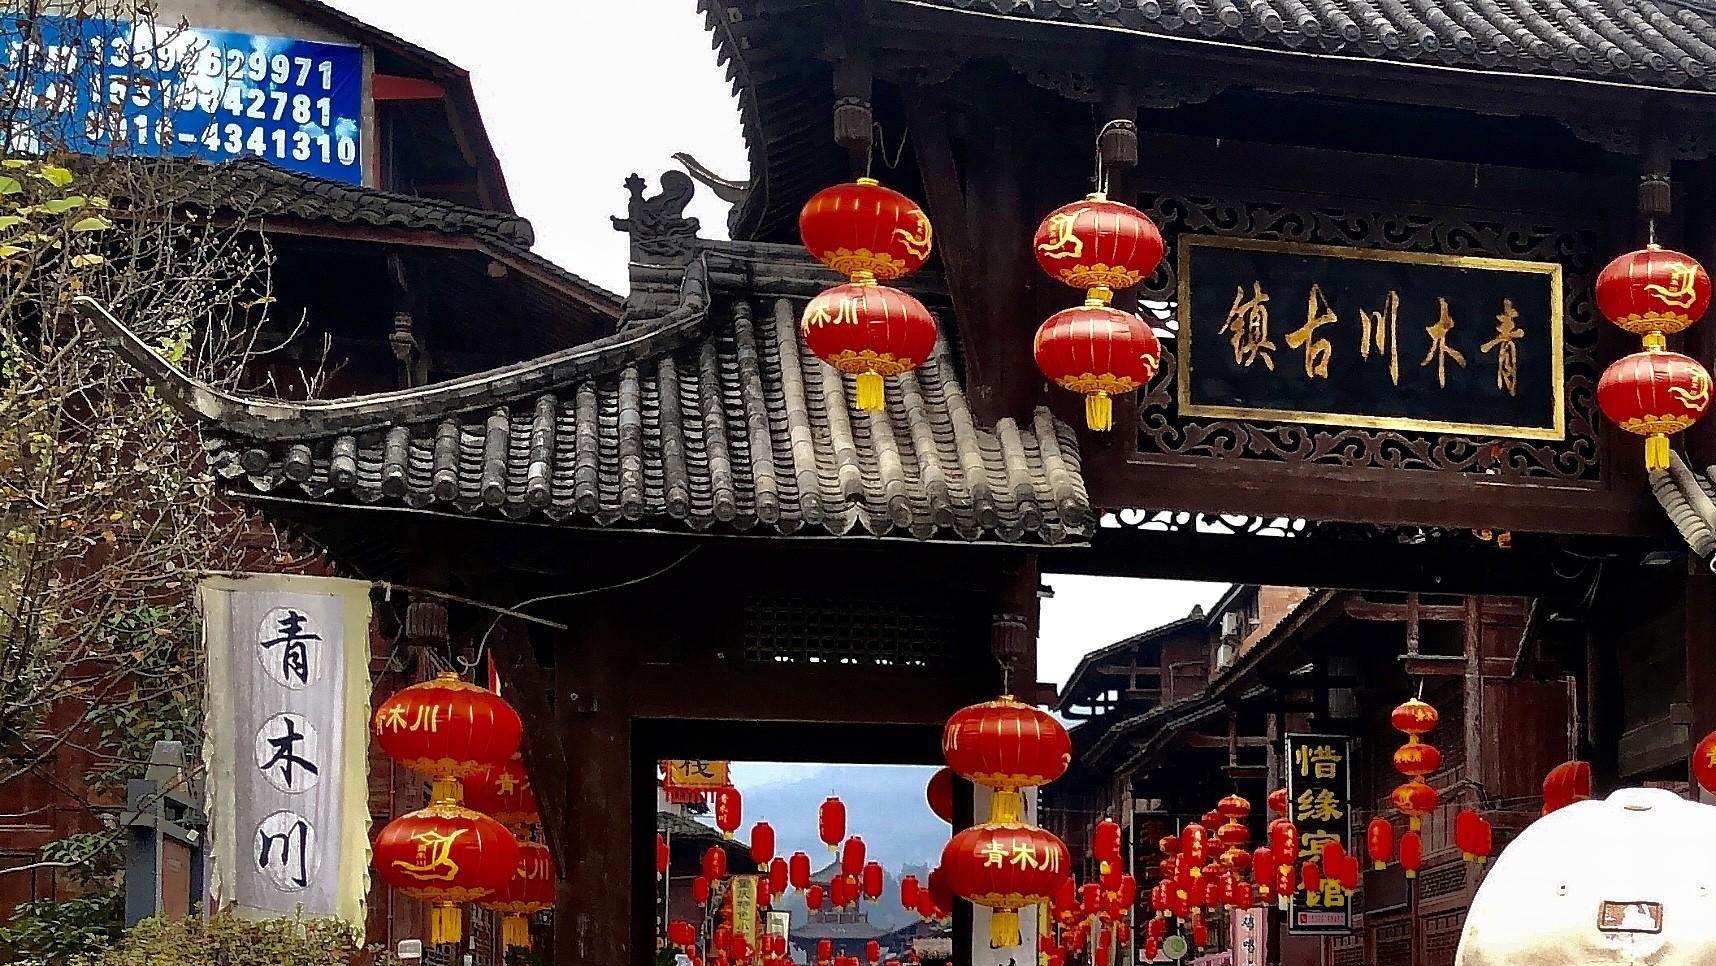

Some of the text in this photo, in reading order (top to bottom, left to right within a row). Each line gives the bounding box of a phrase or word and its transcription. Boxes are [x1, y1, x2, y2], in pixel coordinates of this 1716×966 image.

[260, 610, 323, 887] 青木川
[980, 837, 1060, 874] 青木川
